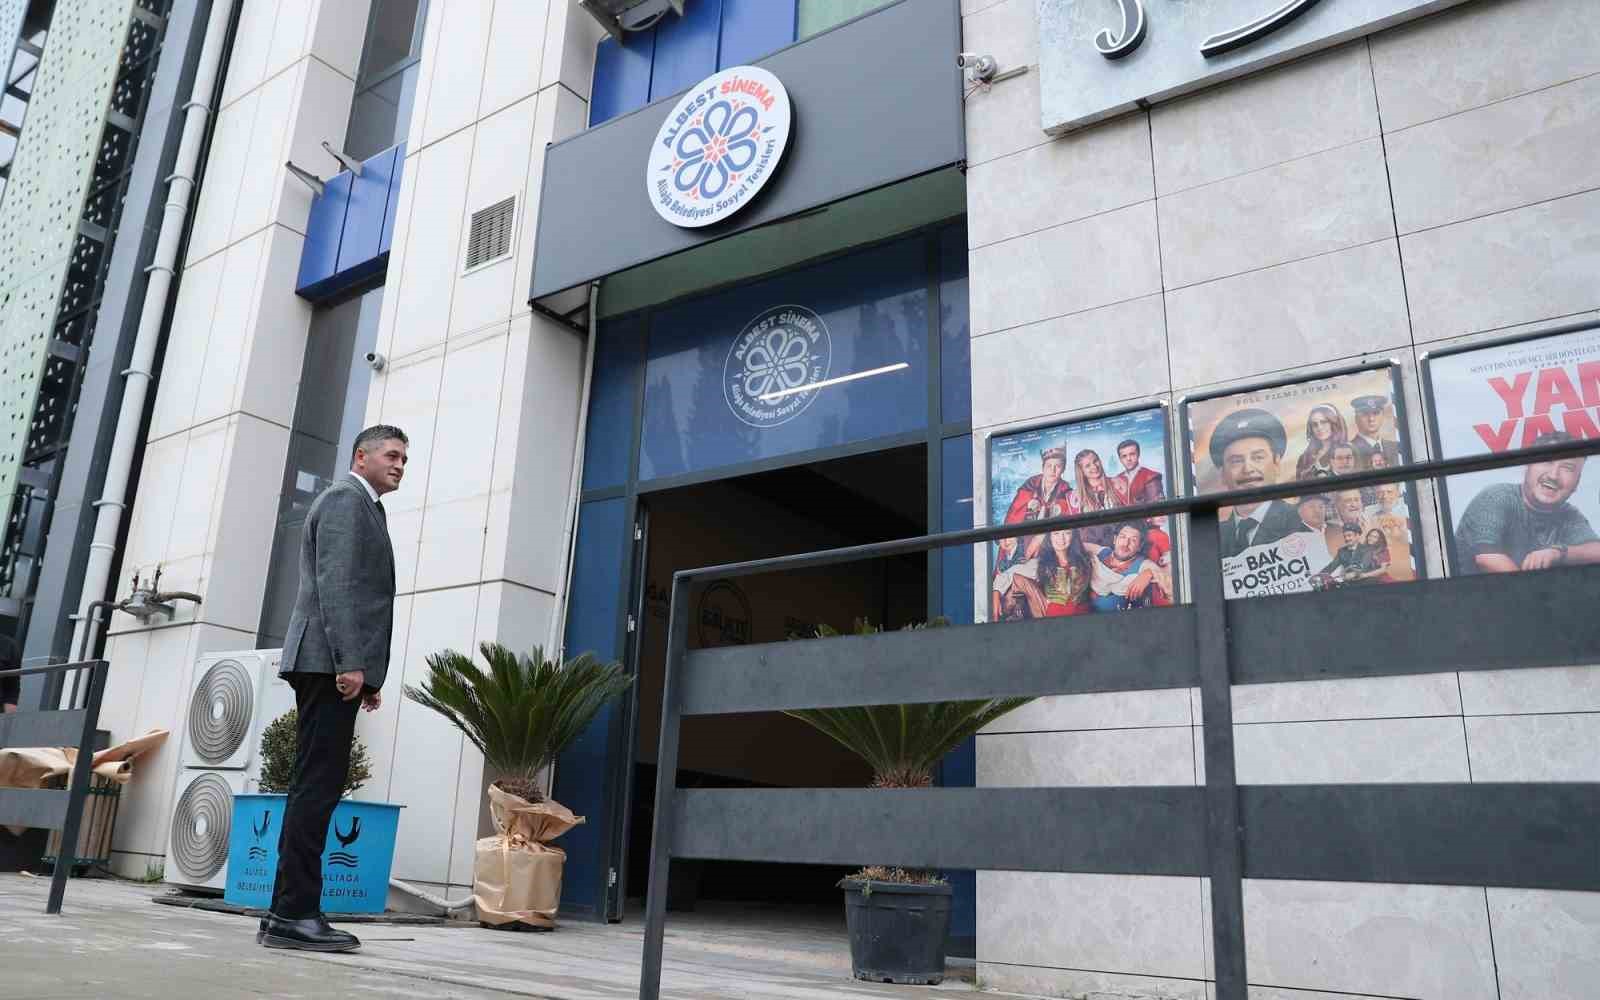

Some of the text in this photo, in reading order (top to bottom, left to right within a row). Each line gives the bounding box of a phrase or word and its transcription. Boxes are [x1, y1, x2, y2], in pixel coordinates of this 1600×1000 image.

[663, 75, 775, 149] ALBEST SİNEMA
[669, 200, 714, 221] Belediyesi
[715, 183, 748, 212] Sosyal
[745, 138, 776, 185] Tesisleri
[735, 310, 820, 360] ALBEST SİNEMA
[776, 397, 802, 417] Sosyal
[1246, 547, 1284, 571] BAK
